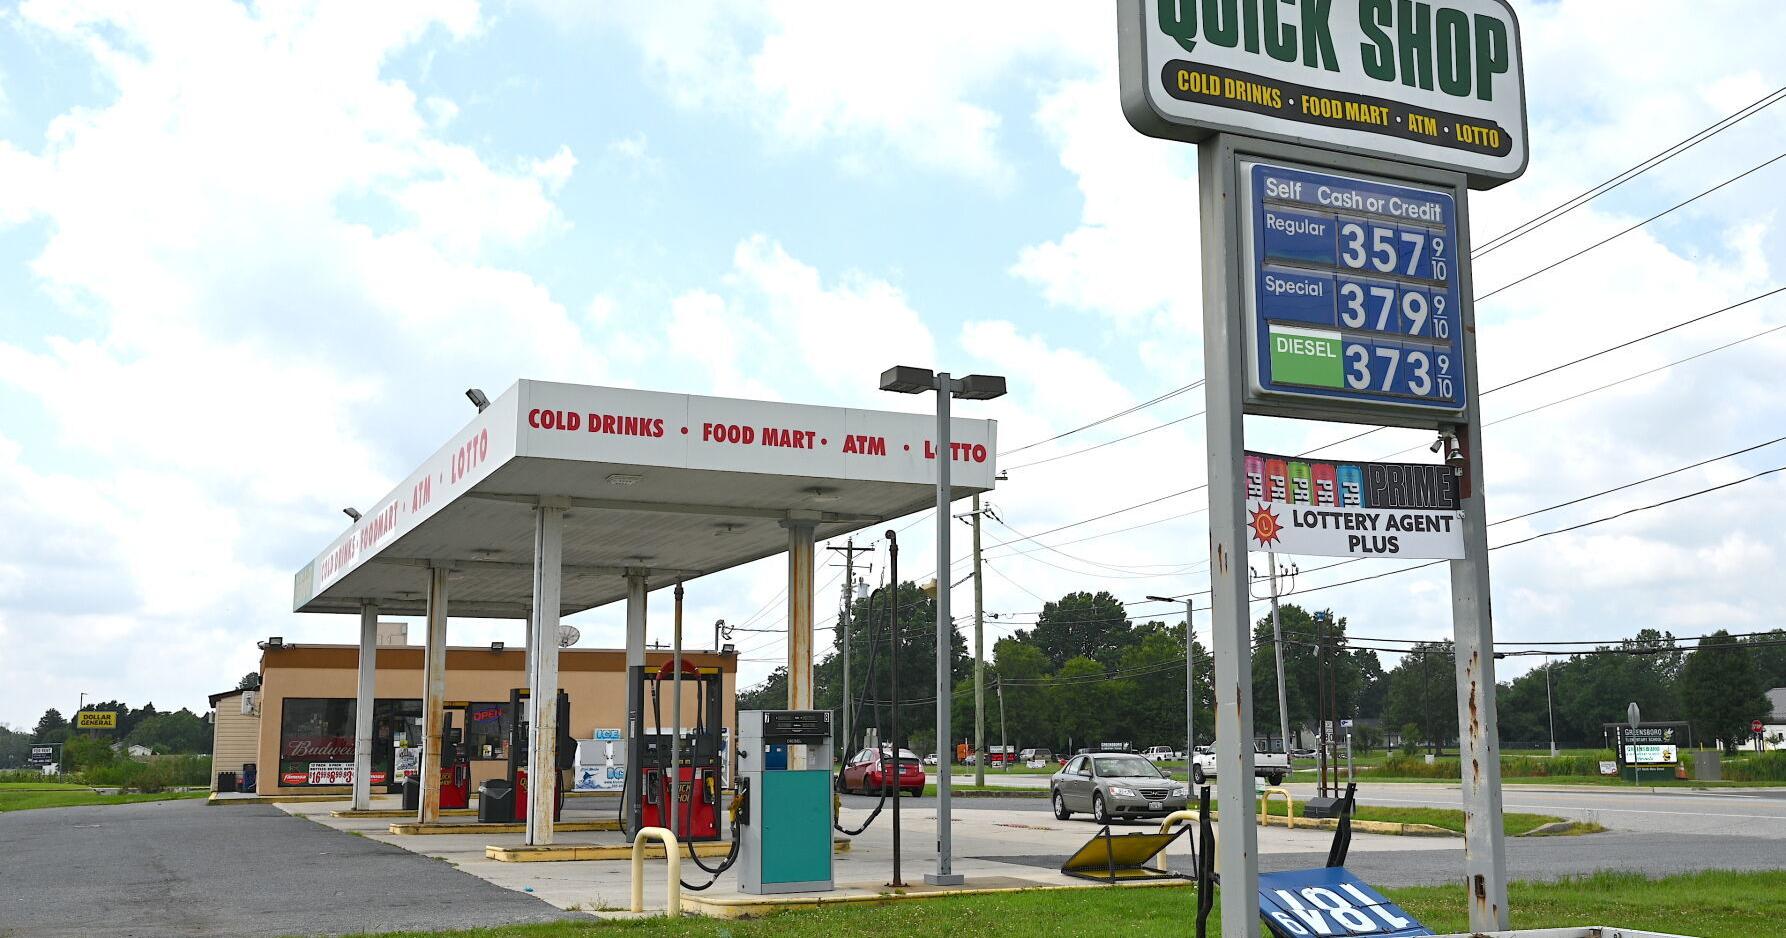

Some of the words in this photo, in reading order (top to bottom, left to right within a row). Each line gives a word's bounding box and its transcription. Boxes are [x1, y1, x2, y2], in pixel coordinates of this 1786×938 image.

[1358, 0, 1508, 101] SHOP
[1177, 70, 1221, 97] COLD
[1224, 75, 1282, 109] DRINKS
[1301, 95, 1343, 120] FOOD
[1345, 101, 1389, 126] MART
[1408, 112, 1437, 137] ATM
[1455, 123, 1500, 149] LOTTO
[1266, 177, 1302, 200] Self
[1317, 186, 1363, 210] Cash
[1366, 196, 1385, 212] or
[1389, 198, 1443, 223] Credit
[1266, 213, 1326, 237] Regular
[1341, 223, 1425, 277] 357
[1265, 275, 1323, 297] Special
[1340, 283, 1428, 336] 379
[1276, 337, 1337, 358] DIESEL
[1345, 344, 1432, 397] 373
[528, 408, 581, 432] COLD
[587, 414, 665, 439] DRINKS
[703, 422, 755, 445] FOOD
[761, 428, 816, 450] MART
[843, 434, 887, 456] ATM
[924, 440, 987, 463] LTTO
[412, 474, 431, 514] ATM
[451, 427, 488, 484] LOTTO
[1368, 463, 1453, 509] PRIME
[1293, 509, 1381, 532] LOTTERY
[1385, 514, 1454, 533] AGENT
[1348, 535, 1401, 553] PLUS
[473, 707, 504, 721] OPEN
[596, 729, 621, 740] ICE
[1624, 728, 1662, 736] GRENSBORO
